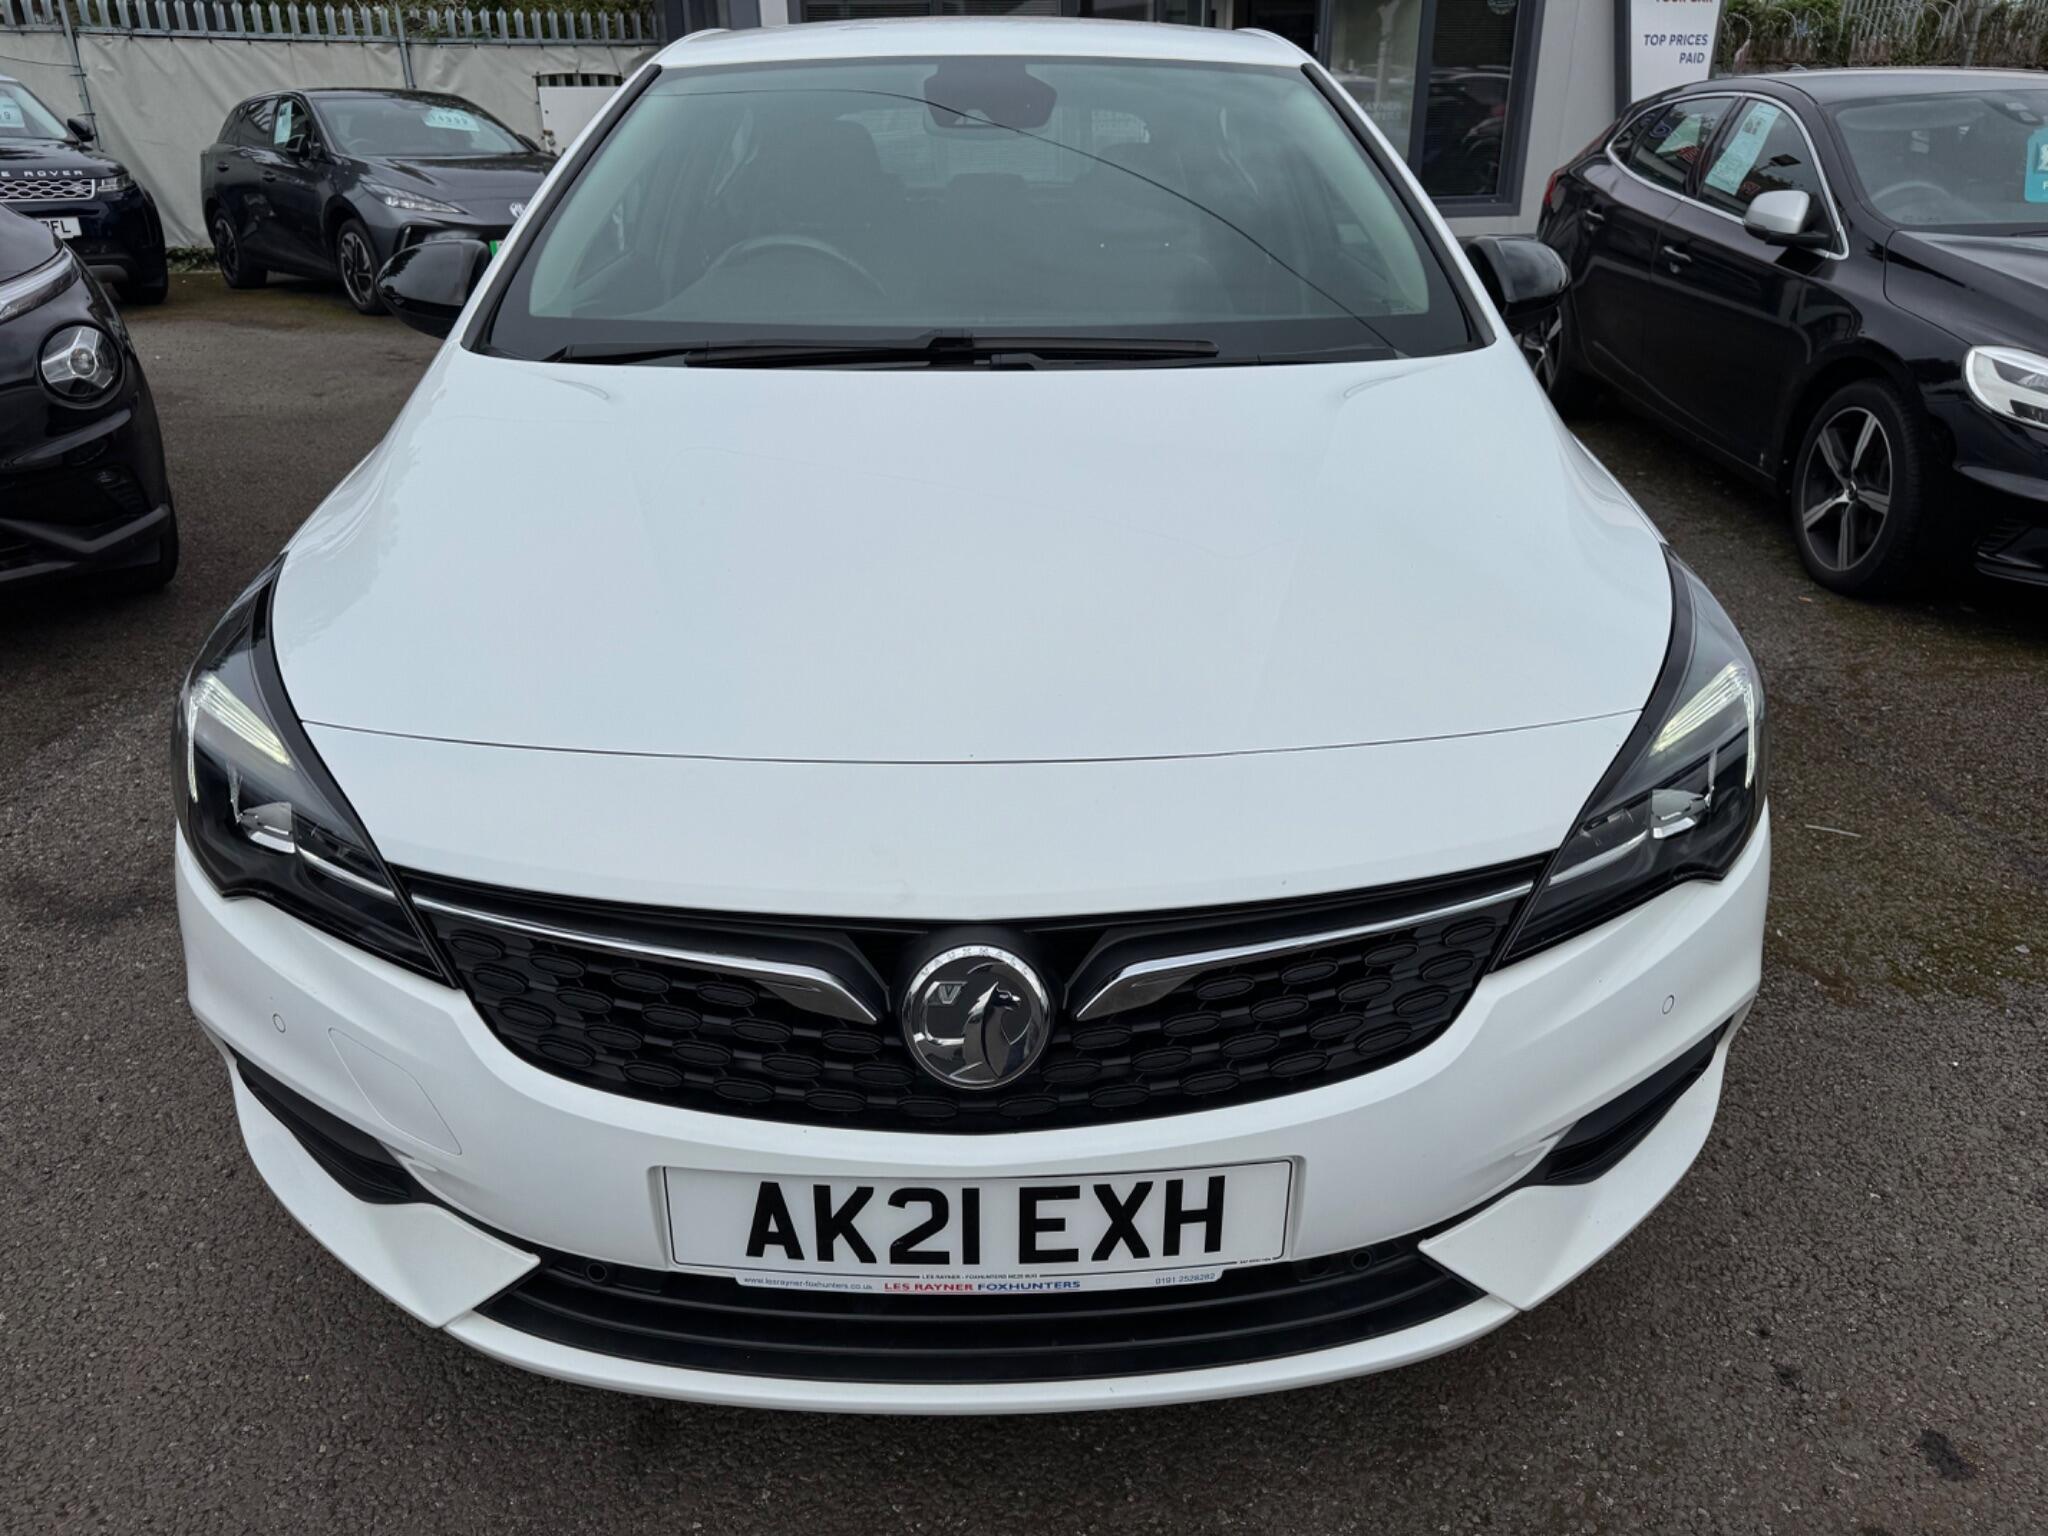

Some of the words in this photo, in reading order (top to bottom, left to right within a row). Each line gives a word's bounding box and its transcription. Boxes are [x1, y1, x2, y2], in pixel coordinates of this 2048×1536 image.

[1644, 34, 1666, 46] TOP
[1669, 34, 1708, 46] PRICES
[1679, 52, 1705, 64] PAID
[745, 1181, 980, 1265] AK21
[1018, 1175, 1226, 1264] EXH
[884, 1282, 910, 1291] LES
[914, 1282, 973, 1291] RAYNER
[977, 1281, 1080, 1291] FOXHUNTERS
[1155, 1276, 1175, 1285] 0191
